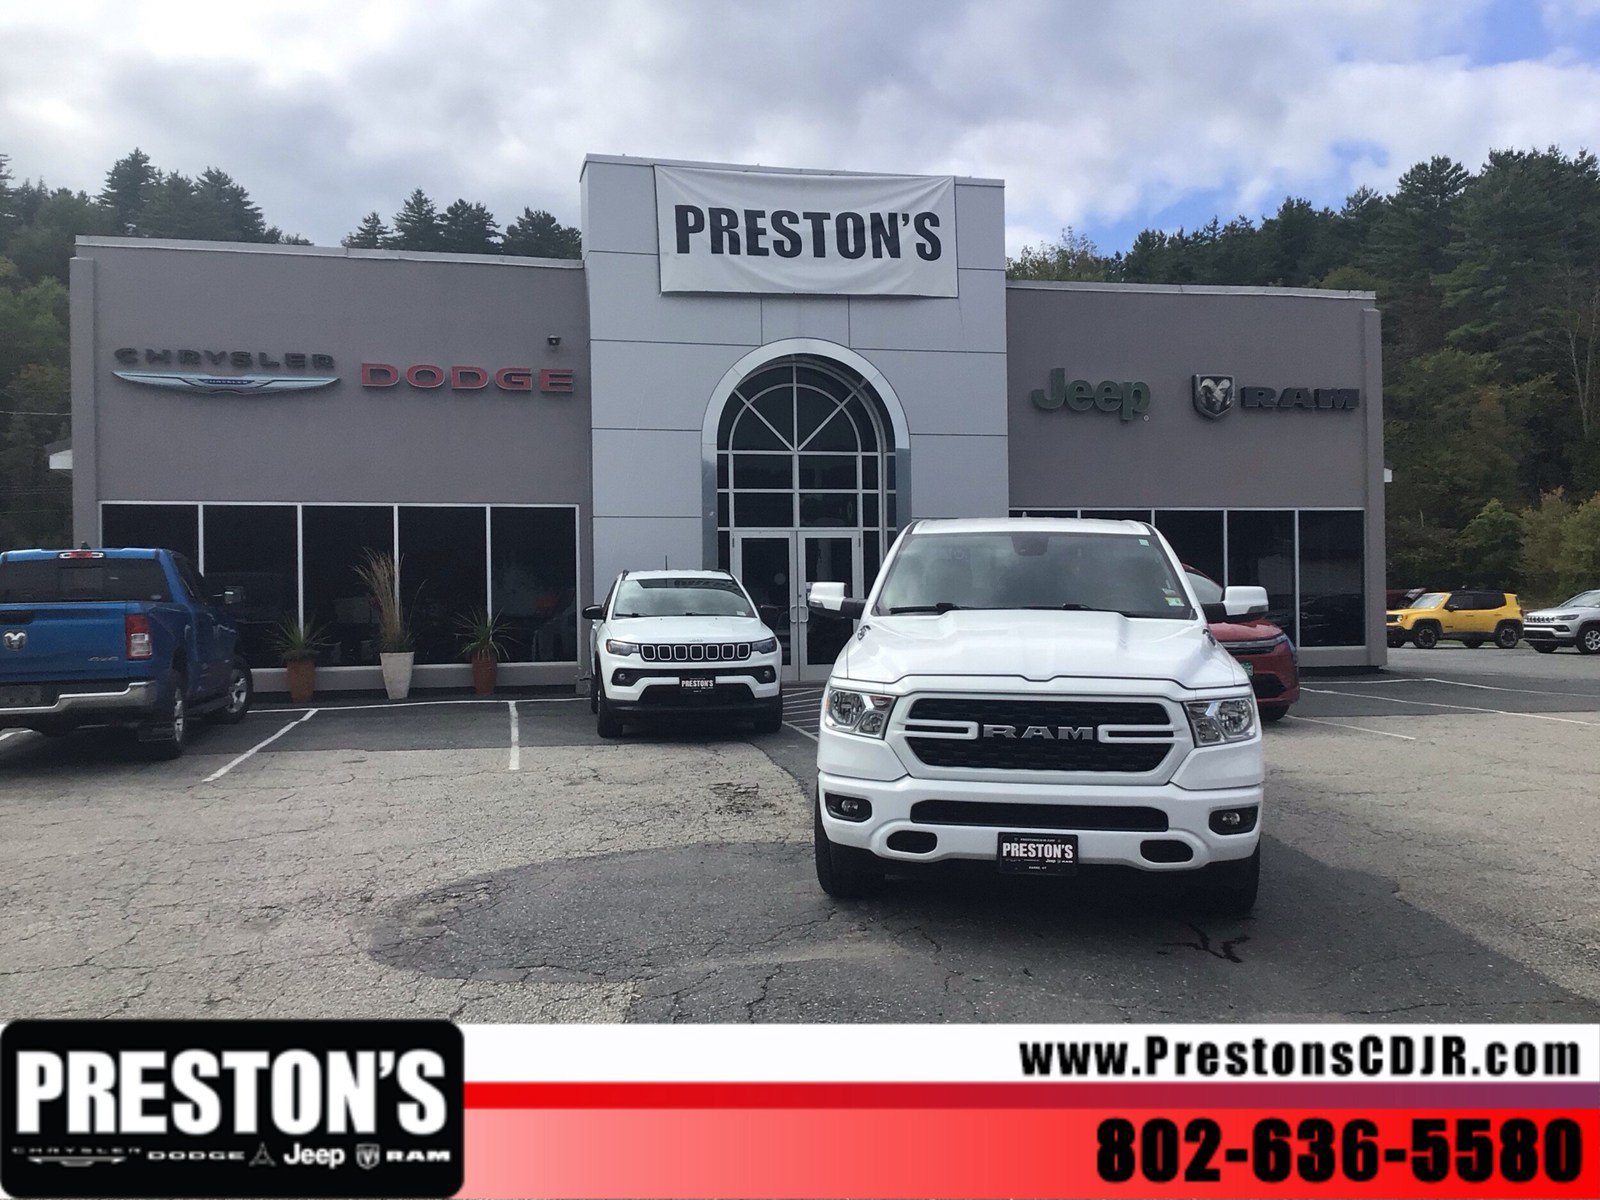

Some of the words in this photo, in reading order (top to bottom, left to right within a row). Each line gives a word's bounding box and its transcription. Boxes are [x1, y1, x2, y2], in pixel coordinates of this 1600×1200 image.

[674, 204, 942, 261] PRESTON'S
[114, 347, 335, 370] CHRYSLER
[361, 362, 575, 392] DODGE
[1030, 367, 1151, 421] Jeep
[1240, 386, 1360, 411] RAM
[983, 724, 1093, 740] RAM
[1002, 842, 1074, 859] PRESTON'S
